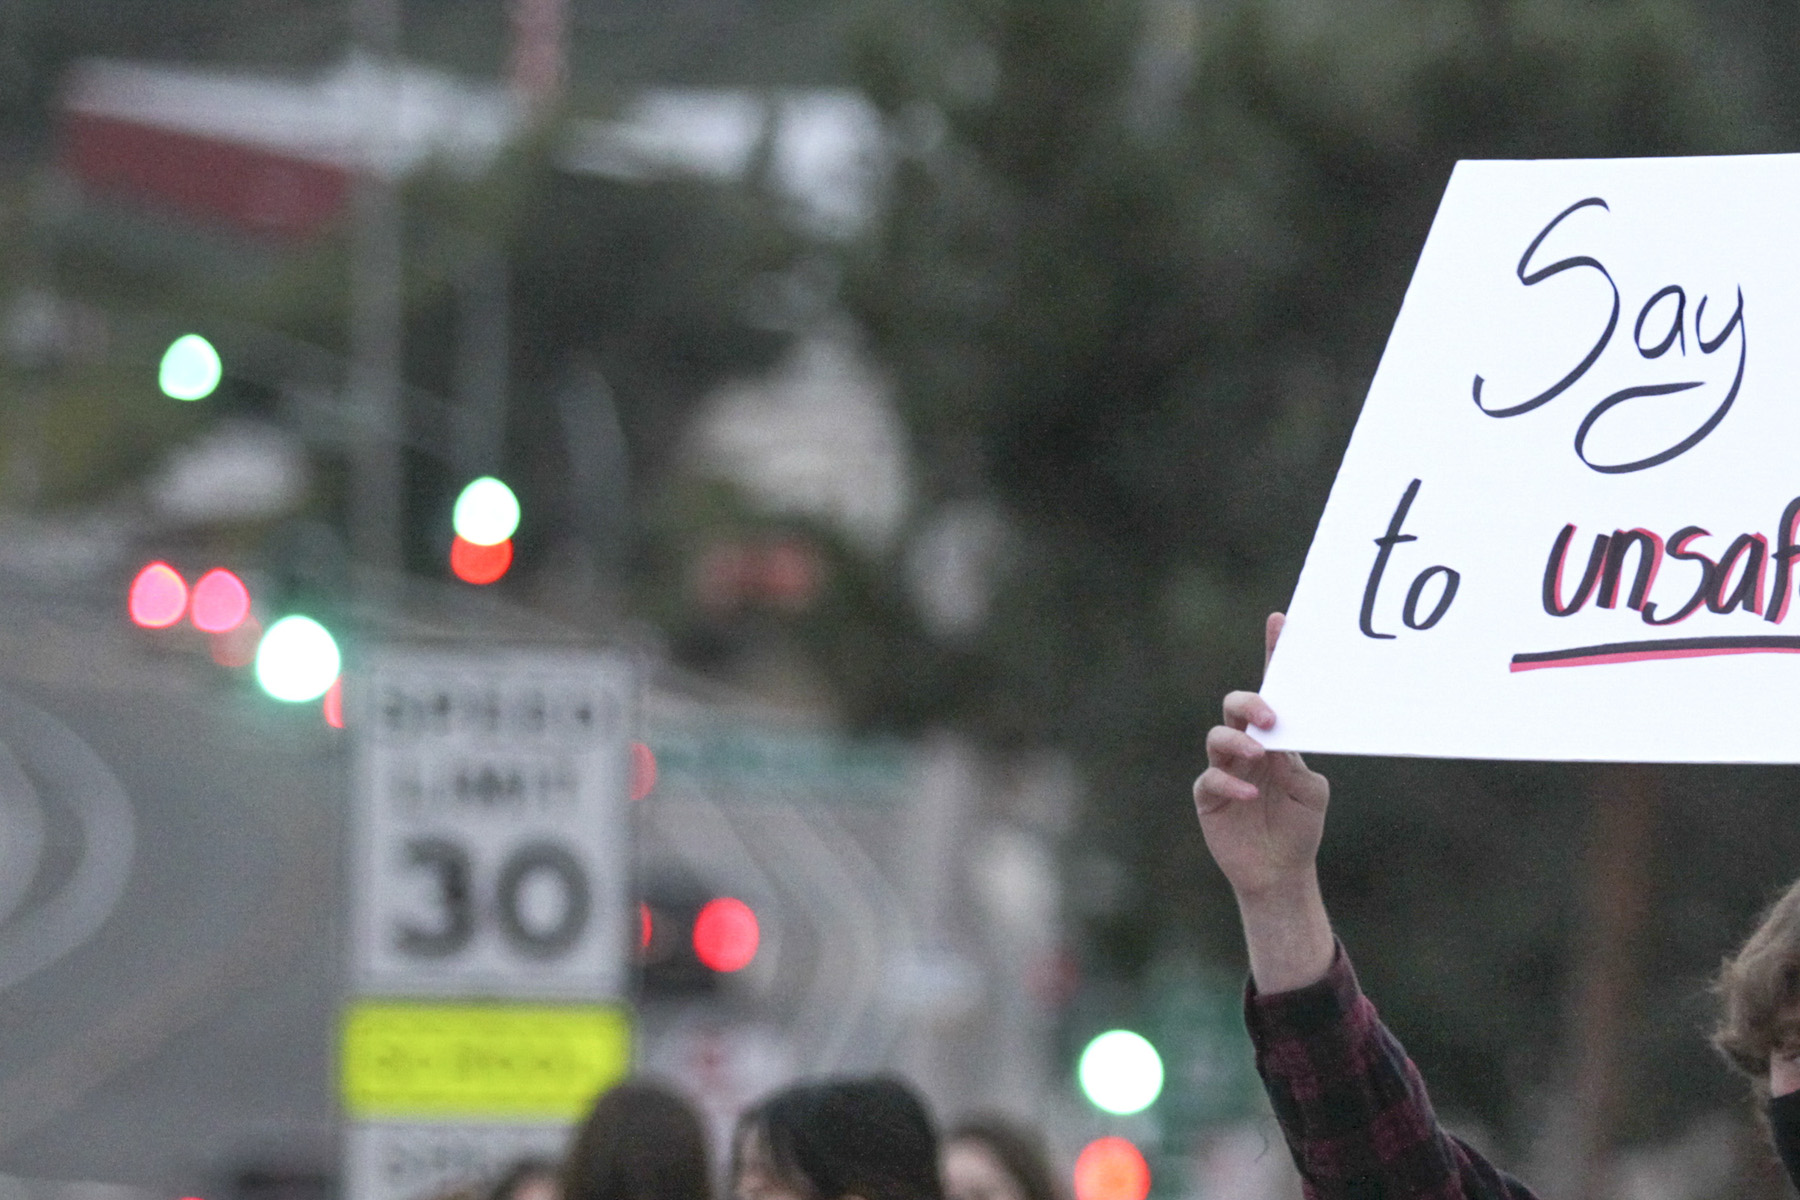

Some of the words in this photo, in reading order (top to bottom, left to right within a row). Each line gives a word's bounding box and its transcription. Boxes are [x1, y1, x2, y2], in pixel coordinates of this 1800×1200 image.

[1472, 196, 1745, 474] Say
[1360, 478, 1460, 640] to
[393, 837, 592, 961] 30
